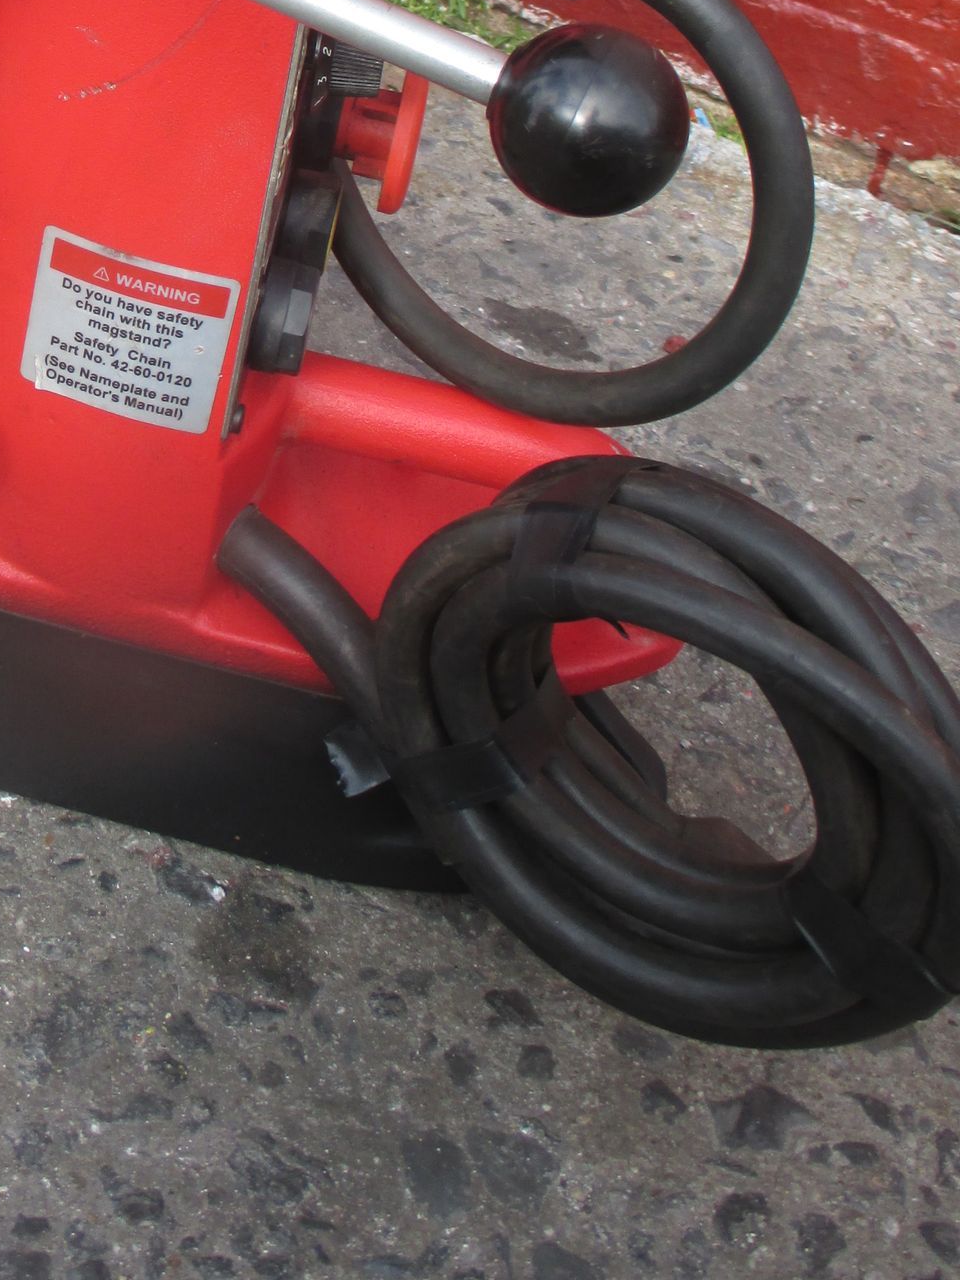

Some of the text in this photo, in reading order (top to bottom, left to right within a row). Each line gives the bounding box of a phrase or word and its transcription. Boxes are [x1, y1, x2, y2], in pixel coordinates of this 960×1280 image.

[322, 46, 332, 57] 2
[317, 76, 327, 86] 3
[61, 277, 204, 330] Do you have safety
[116, 272, 201, 305] WARNING
[75, 299, 184, 339] chain with this
[88, 317, 173, 350] magstand?
[50, 336, 193, 388] Part No. 42-60-0120
[74, 332, 172, 370] Safety Chain
[44, 353, 190, 407] (See Nameplate and
[46, 368, 184, 421] Operator's Manual)
